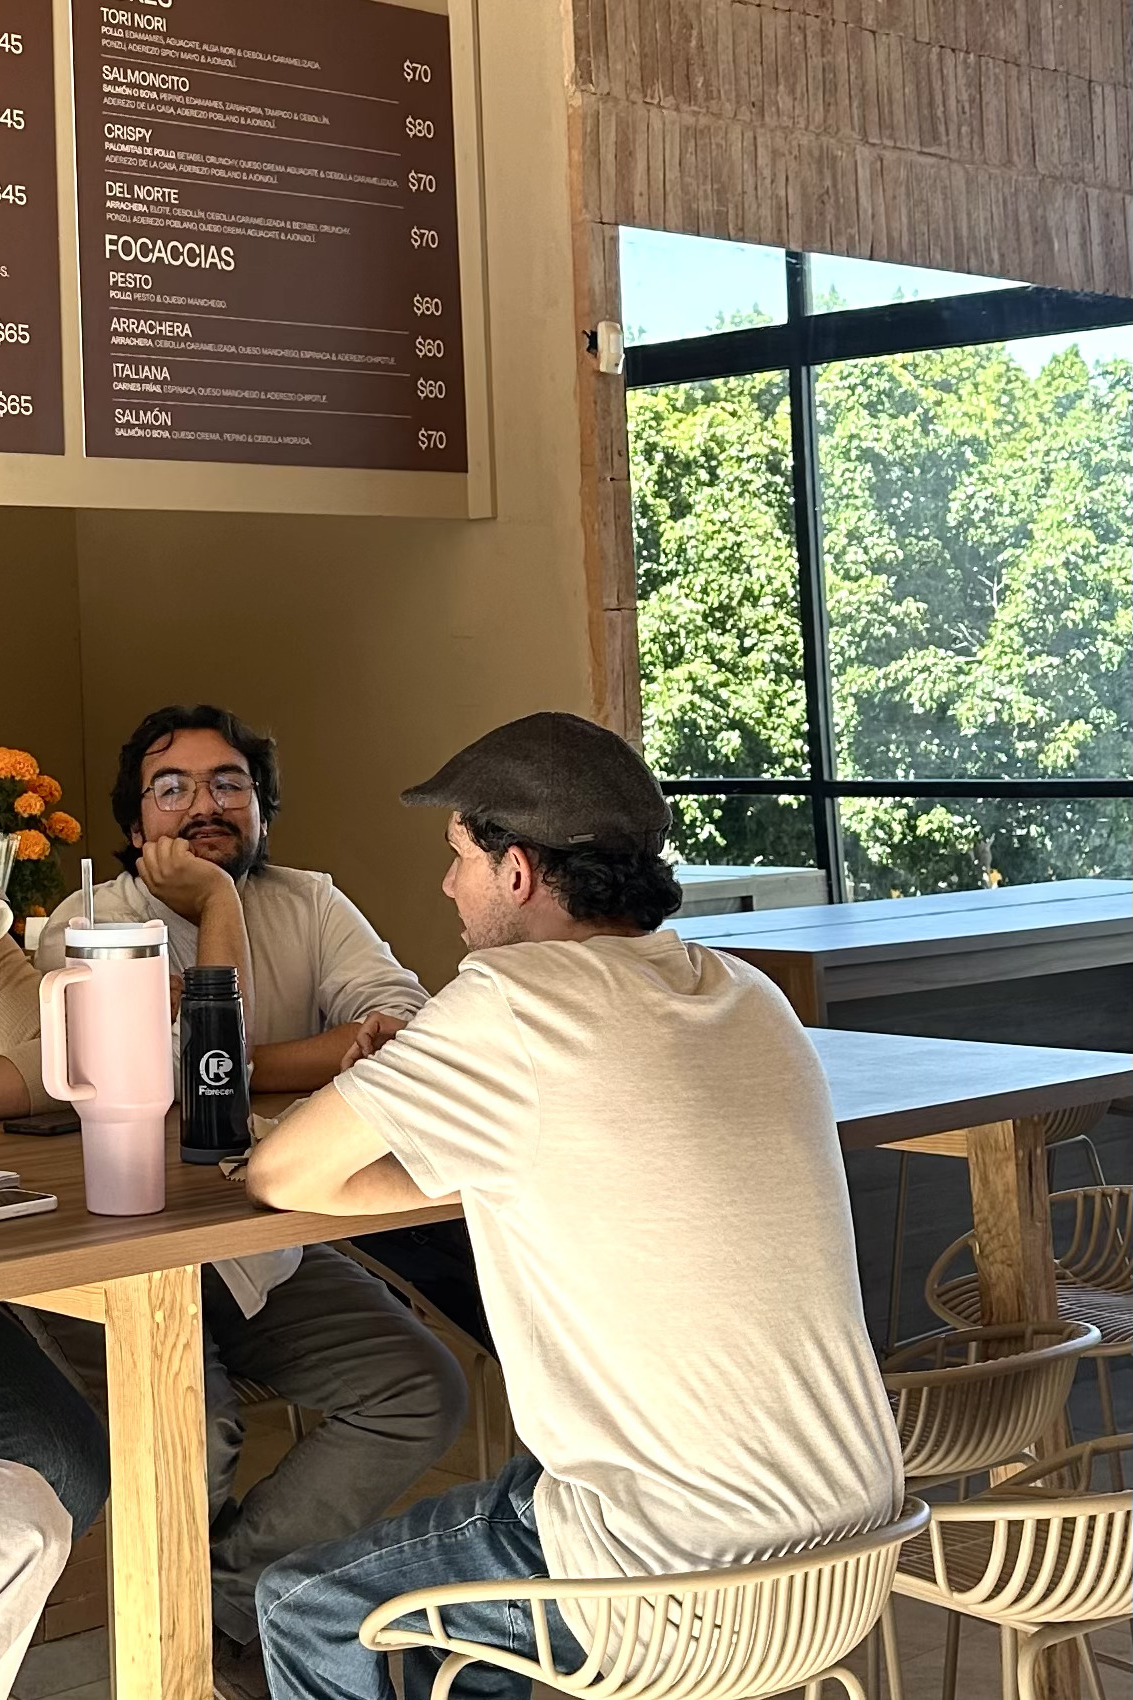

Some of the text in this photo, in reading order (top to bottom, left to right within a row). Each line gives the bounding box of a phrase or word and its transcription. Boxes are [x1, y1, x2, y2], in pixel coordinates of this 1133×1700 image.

[100, 7, 167, 32] TORI NORI
[201, 54, 206, 63] &
[102, 65, 189, 92] SALMONCITO
[403, 59, 431, 83] $70
[137, 101, 146, 111] DE
[147, 103, 156, 112] LA
[104, 123, 152, 143] CRISPY
[406, 115, 434, 138] $80
[144, 147, 153, 156] DE
[139, 159, 148, 167] DE
[149, 160, 158, 169] LA
[105, 181, 179, 204] DEL NORTE
[408, 170, 436, 193] $70
[410, 226, 438, 249] $70
[105, 234, 235, 271] FOCACCIAS
[109, 271, 152, 289] PESTO
[156, 294, 162, 302] &
[413, 294, 442, 316] $60
[110, 316, 192, 338] ARRACHERA
[416, 335, 444, 358] $60
[113, 362, 170, 381] ITALIANA
[417, 377, 445, 400] $60
[115, 408, 172, 426] SALMÓN
[418, 427, 446, 450] $70
